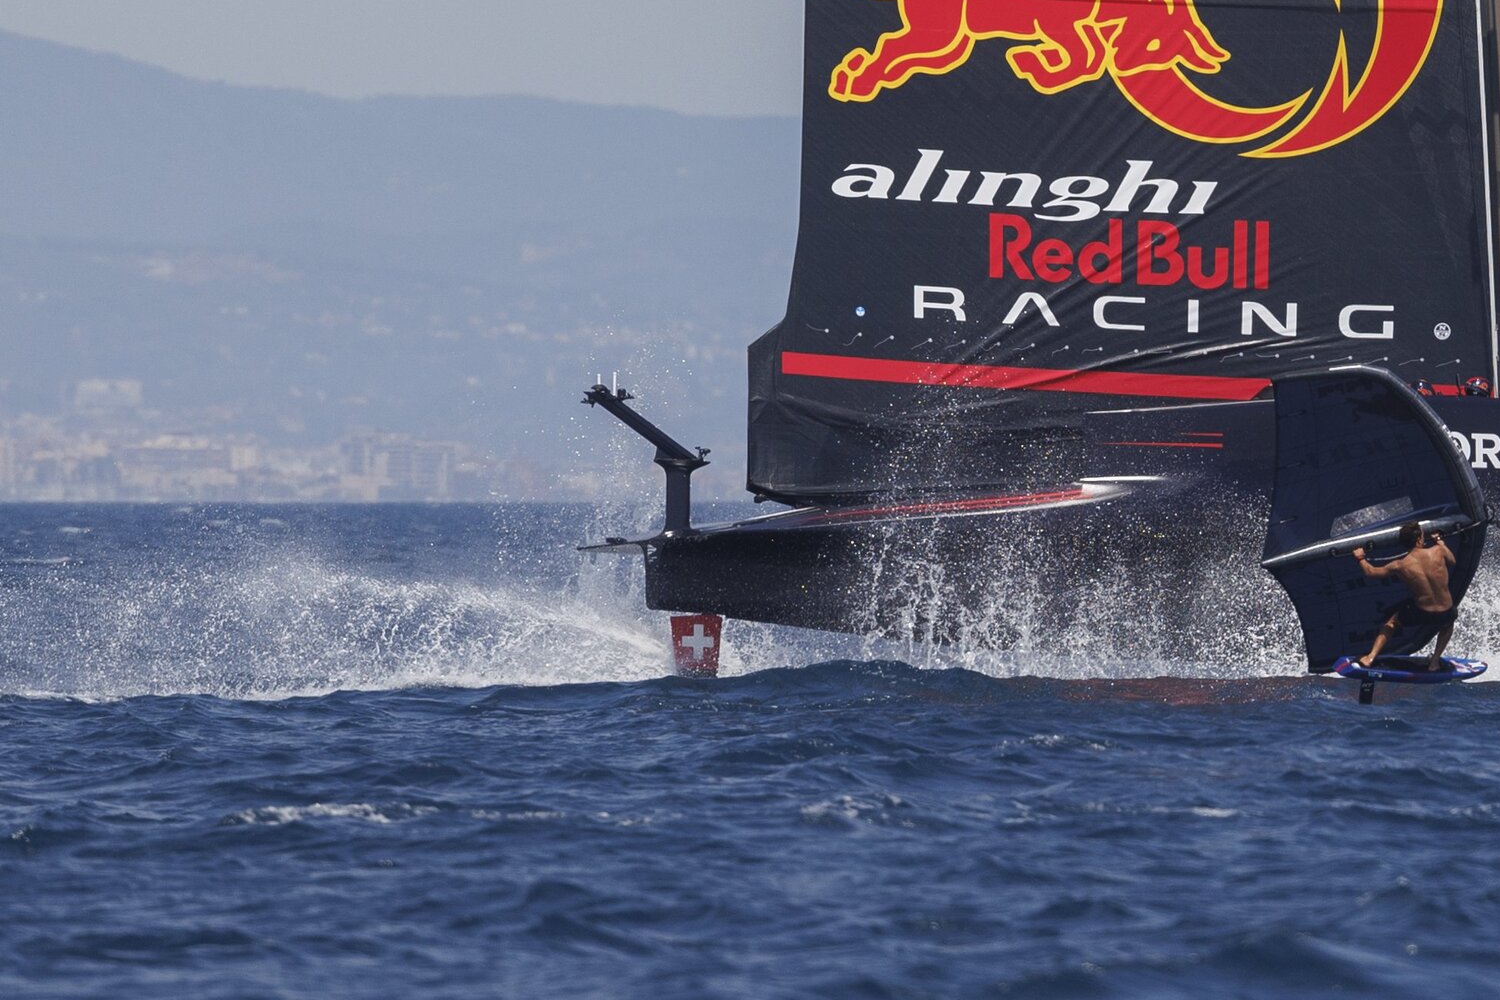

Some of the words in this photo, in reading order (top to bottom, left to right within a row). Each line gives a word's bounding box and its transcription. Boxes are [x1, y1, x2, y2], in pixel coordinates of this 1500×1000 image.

[832, 148, 1218, 221] alinghi
[988, 213, 1123, 284] Red
[1136, 219, 1270, 290] Bull
[913, 285, 1394, 339] RACING
